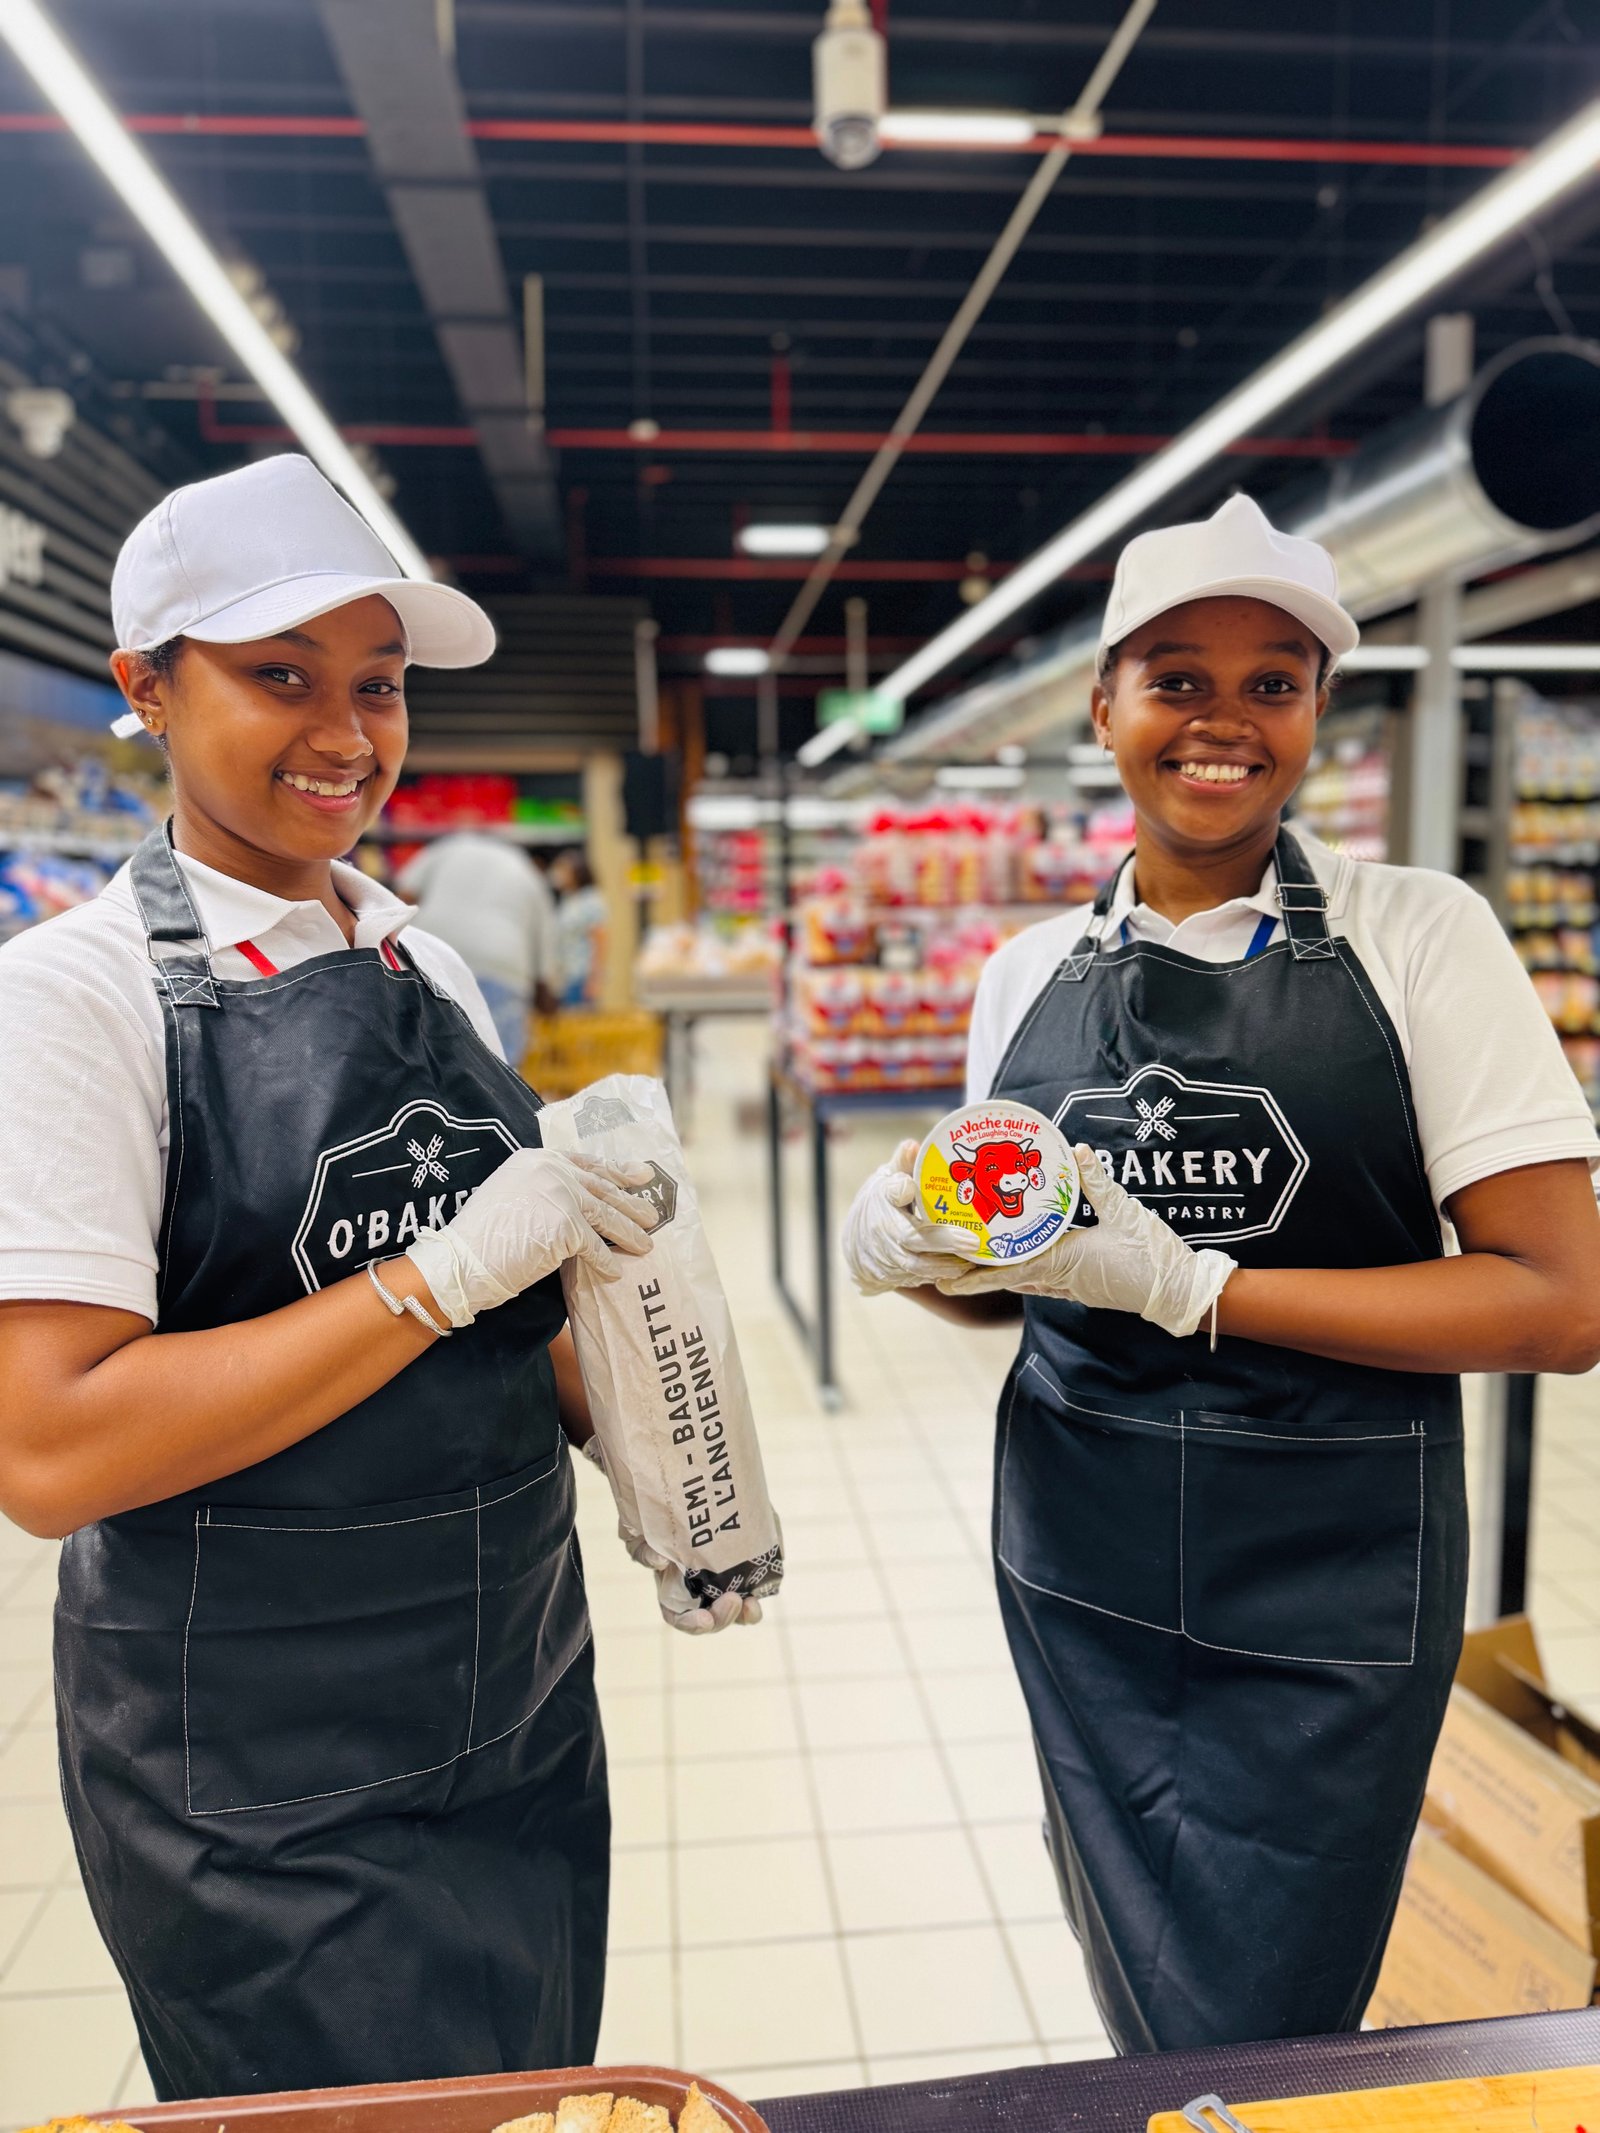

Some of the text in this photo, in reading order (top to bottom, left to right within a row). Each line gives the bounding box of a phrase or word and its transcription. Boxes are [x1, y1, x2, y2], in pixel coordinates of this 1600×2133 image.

[949, 1117, 1040, 1142] La Vache qui rit
[965, 1135, 978, 1144] The
[977, 1129, 1009, 1139] Laughing
[1095, 1147, 1271, 1186] BAKERY
[925, 1183, 953, 1192] SPÉCIALE
[930, 1176, 949, 1184] OFFRE
[934, 1194, 949, 1214] 4
[1168, 1206, 1246, 1220] PASTRY
[994, 1241, 1006, 1252] 24
[1014, 1218, 1060, 1254] ORIGINAL
[638, 1278, 696, 1446] BAGUETTE
[681, 1325, 741, 1535] À L'ANCIENNE
[682, 1474, 714, 1548] DEMI
